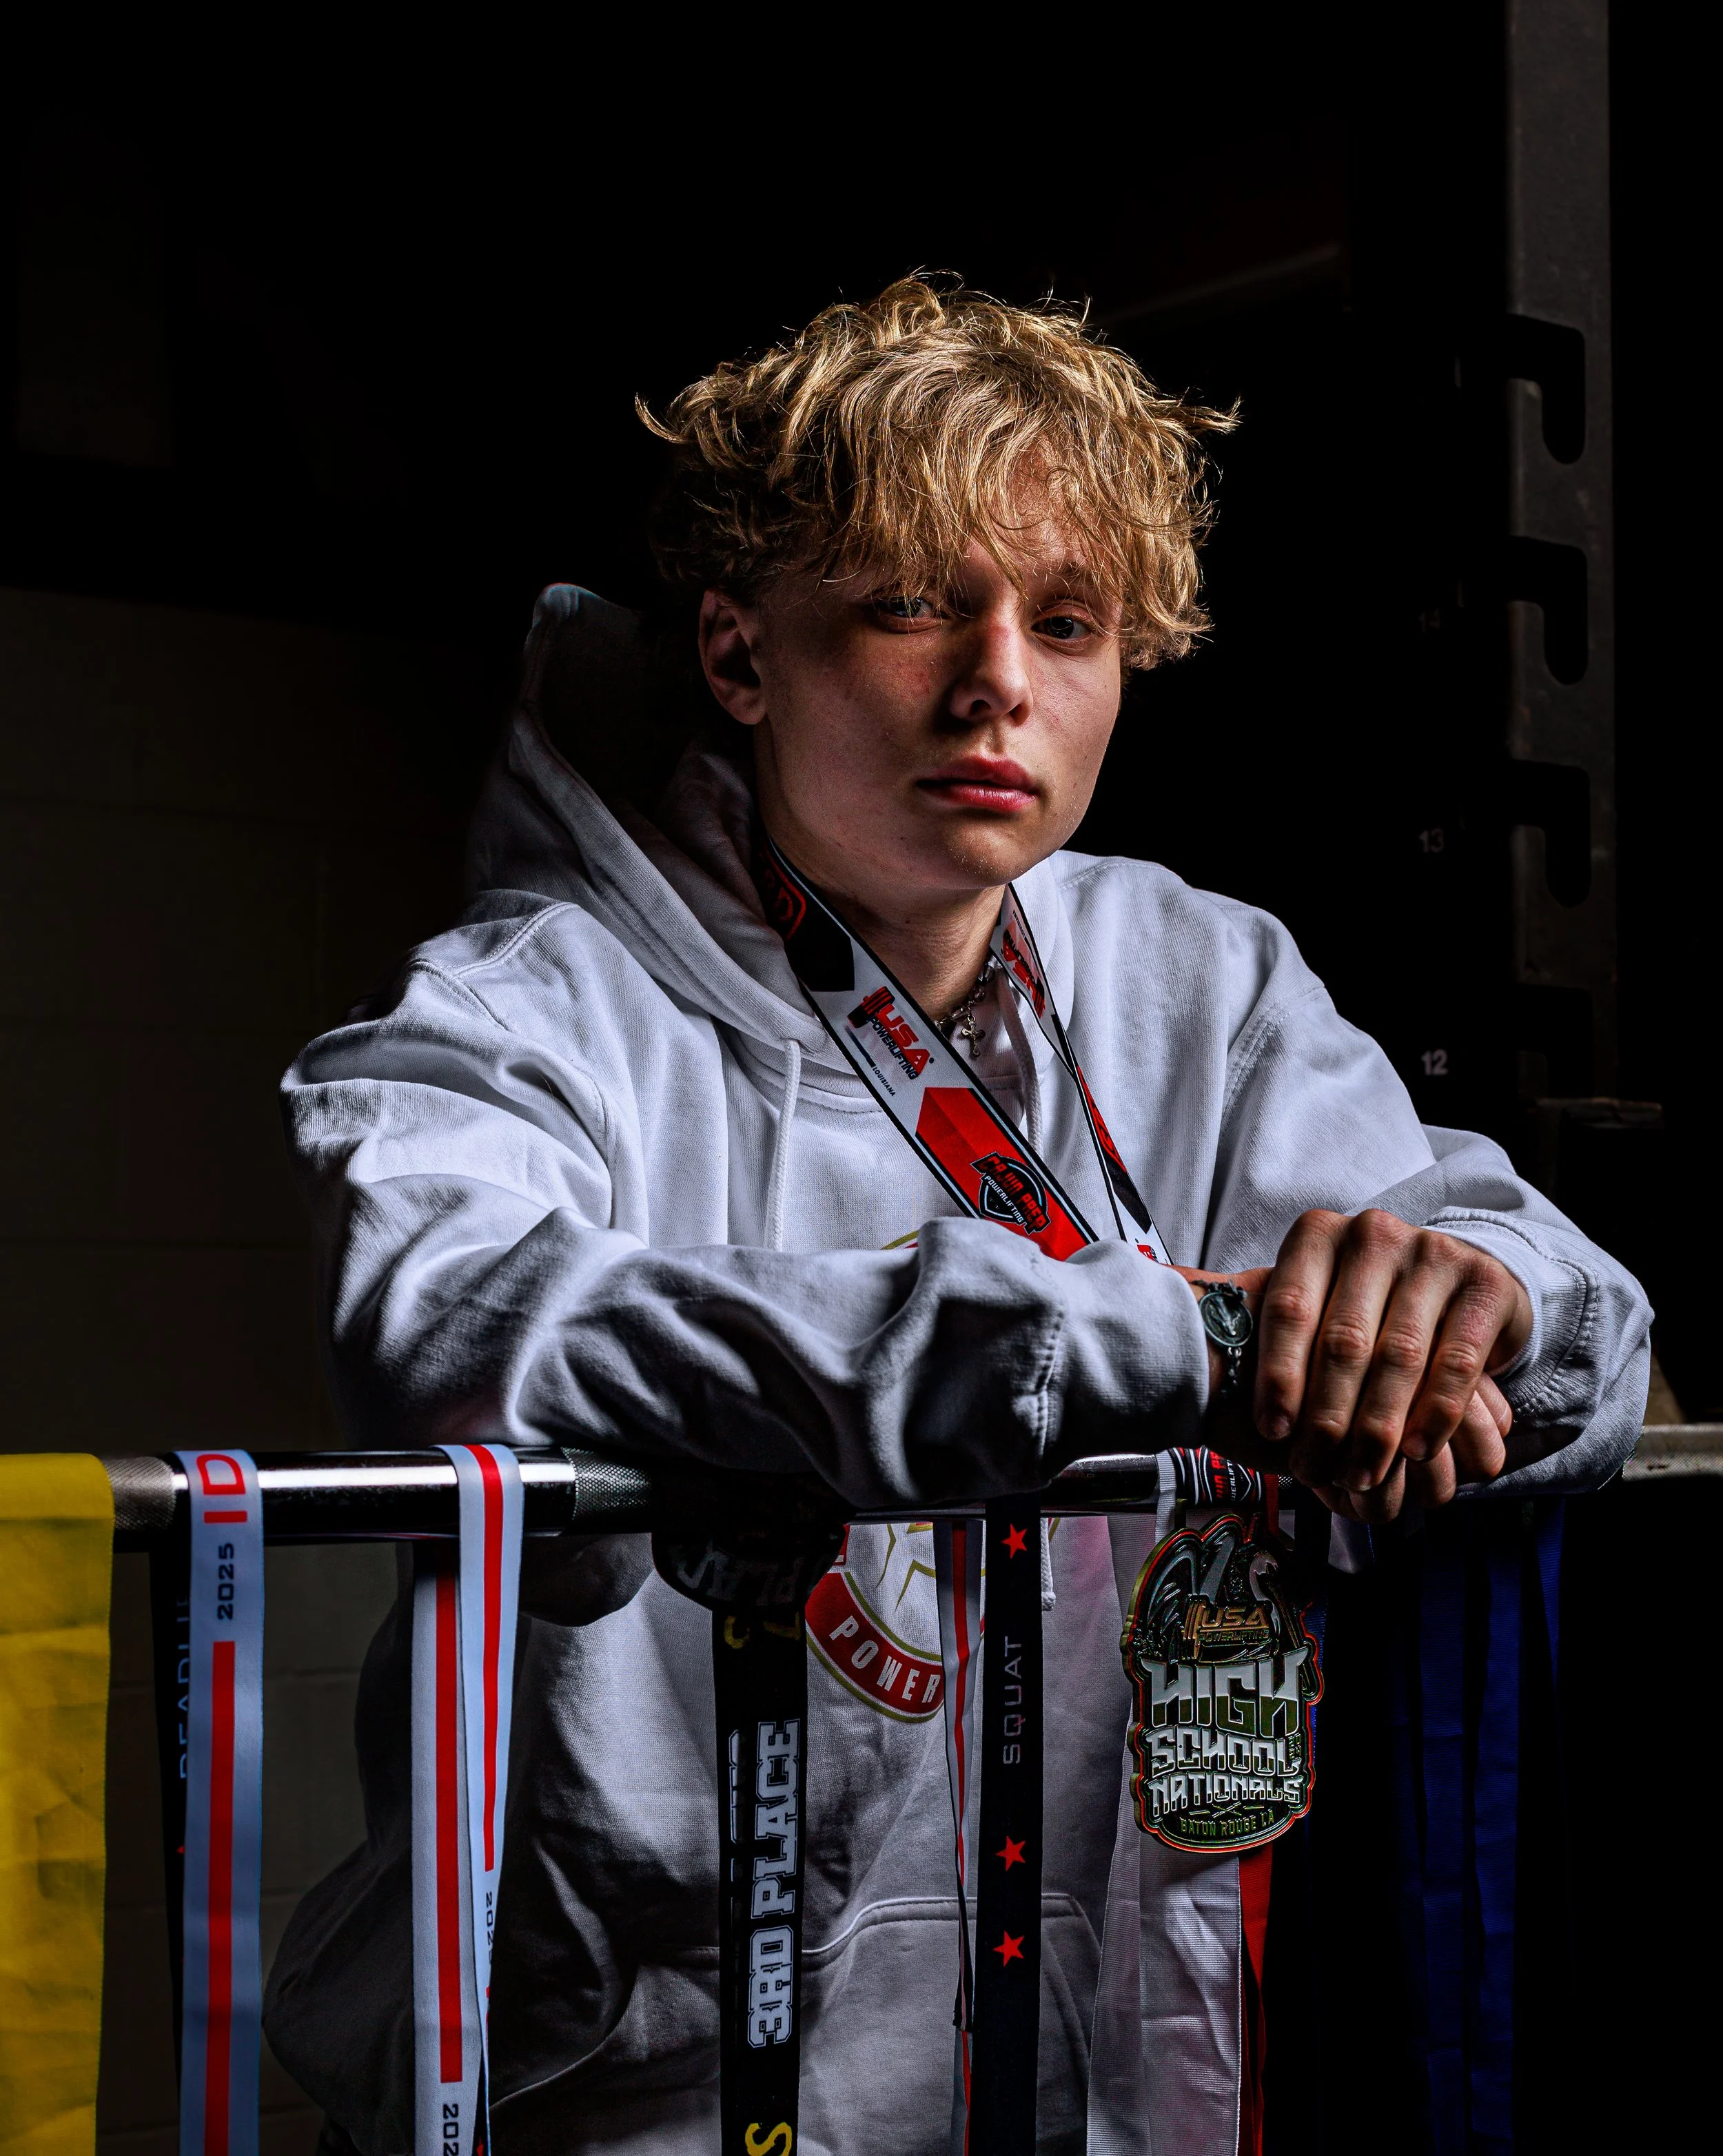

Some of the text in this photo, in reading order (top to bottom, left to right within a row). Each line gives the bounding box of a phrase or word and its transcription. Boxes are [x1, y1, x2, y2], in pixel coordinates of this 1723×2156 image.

[1418, 828, 1444, 853] 13
[868, 1016, 919, 1080] POWERLIFTING
[876, 1003, 930, 1075] USA
[1420, 1048, 1448, 1076] 12
[872, 1066, 896, 1097] LOUISIANA
[979, 1156, 1046, 1230] CAJUN PREP
[984, 1175, 1024, 1223] POWERLIFTING
[217, 1542, 234, 1620] 2025
[1202, 1605, 1269, 1627] USA
[828, 1615, 941, 1704] POWER
[1003, 1636, 1026, 1765] SQUAT
[1141, 1647, 1308, 1738] HIGH
[1145, 1726, 1303, 1778] SCHOOL
[1148, 1773, 1304, 1817] NATIONALS
[1180, 1809, 1274, 1836] BATON ROUGE LA
[748, 1719, 800, 2048] 3RD PLACE
